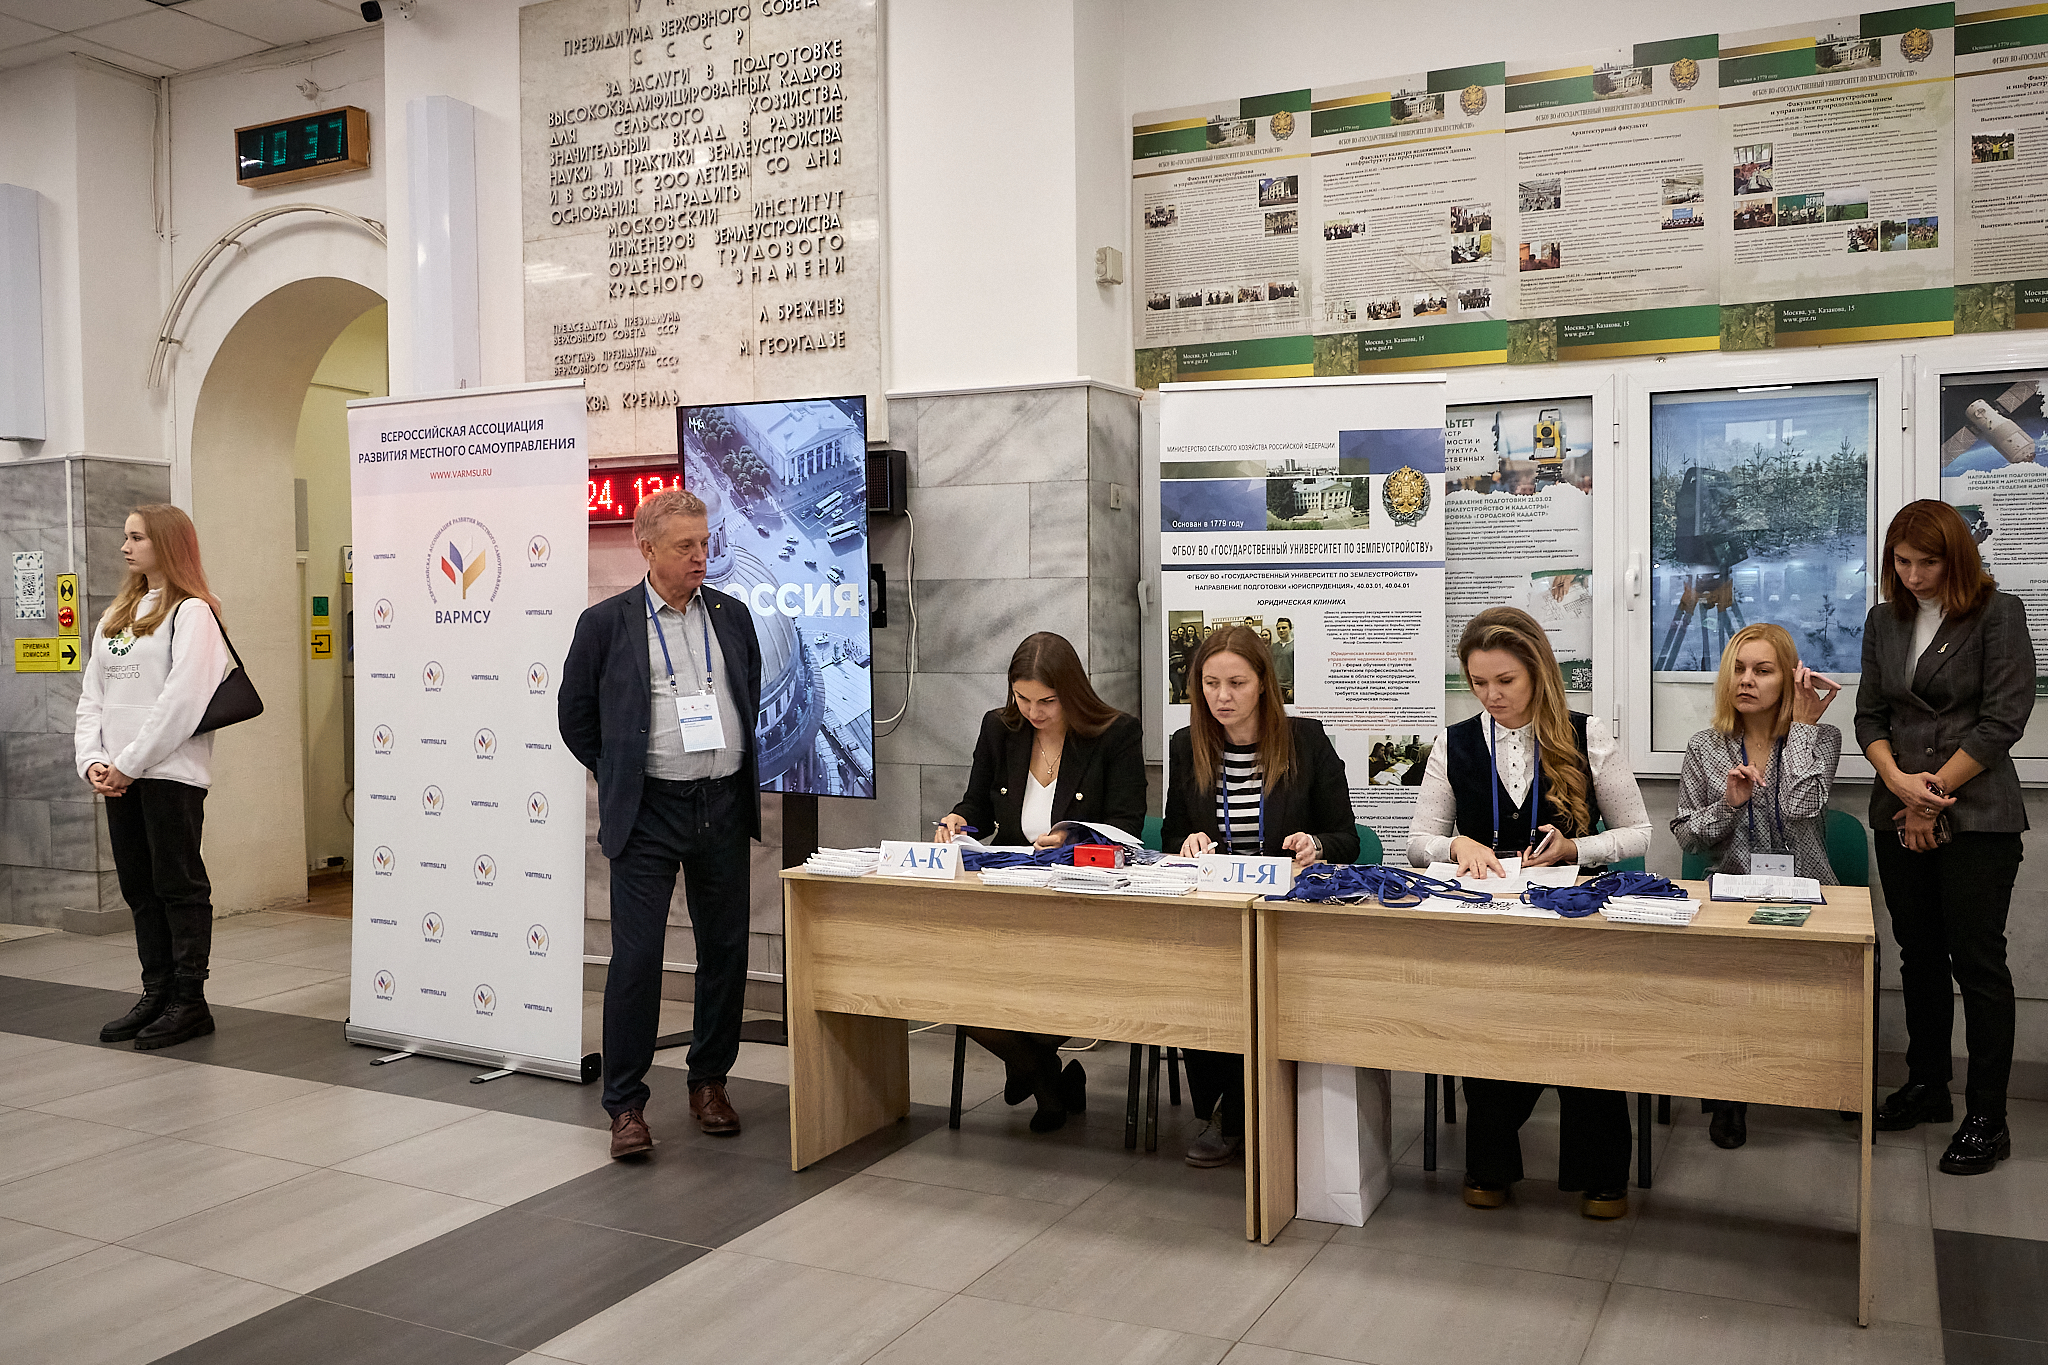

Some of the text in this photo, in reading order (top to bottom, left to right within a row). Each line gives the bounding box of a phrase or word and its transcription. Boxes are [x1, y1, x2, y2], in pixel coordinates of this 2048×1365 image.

[563, 25, 652, 56] ПРЕЗИДИУМА
[660, 4, 751, 36] ВЕРХОВНОГО
[606, 40, 842, 97] ЗА ЗАСЛУГИ В ПОДГОТОВКЕ
[548, 62, 841, 127] ВЫСОКОКВАЛИФИЦИРОВАННЫХ КАДРОВ
[550, 130, 577, 147] ДЛЯ
[613, 108, 703, 135] СЕЛЬСКОГО
[673, 125, 726, 146] ВКЛАД
[742, 121, 749, 136] В
[769, 105, 843, 131] РАЗВИТИЕ
[304, 119, 342, 160] 37
[551, 166, 592, 186] НАУКИ
[603, 162, 612, 176] И
[623, 150, 694, 173] ПРАКТИКИ
[551, 149, 841, 206] И В СВЯЗИ С 200 ЛЕТИЕМ СО ДНЯ
[551, 185, 740, 225] ОСНОВАНИЯ НАГРАДИТЬ
[754, 190, 843, 219] ИНСТИТУТ
[609, 232, 695, 258] ИНЖЕНЕРОВ
[609, 234, 844, 276] ОРДЕНОМ ТРУДОВОГО
[608, 257, 844, 298] КРАСНОГО ЗНАМЕНИ
[760, 298, 844, 322] Л БРЕЖНЕВ
[553, 312, 680, 334] ПРЕДСЕДАТЕЛЬ ПРЕЗИДИУМА
[554, 325, 679, 346] ВЕРХОВНОГО СОВЕТА СССР
[759, 332, 845, 354] ГЕОРГАДЗЕ
[554, 347, 656, 365] СЕКРЕТАРЬ ПРЕЗИДИУМА
[554, 357, 679, 376] ВЕРХОВНОГО СОВЕТА СССР
[622, 391, 679, 410] КРЕМЛЬ
[381, 419, 544, 443] ВСЕРОССИЙСКАЯ АССОЦИАЦИЯ
[358, 438, 575, 464] РАЗВИТИЯ МЕСТНОГО САМОУПРАВЛЕНИЯ
[1208, 444, 1236, 452] СЕЛЬСКОГО
[1238, 443, 1267, 451] ХОЗЯЙСТВА
[1269, 442, 1303, 450] РОССИЙСКОЙ
[430, 468, 492, 479] WWW.VARMSU.RU
[1172, 520, 1202, 528] Основан
[1211, 519, 1226, 527] 1779
[1228, 520, 1244, 529] году
[1172, 540, 1433, 557] ФГБОУ ВО «ГОСУДАРСТВЕННЫЙ УНИВЕРСИТЕТ ПО ЗЕМЛЕУСТРОЙСТВУ»
[1221, 572, 1288, 580] «ГОСУДАРСТВЕННЫЙ
[1288, 583, 1355, 591] «ЮРИСПРУДЕНЦИЯ»,
[706, 582, 859, 617] ОССИЯ
[435, 610, 491, 623] ВАРМСУ
[900, 847, 947, 869] А-К
[1223, 862, 1278, 884] Л-Я
